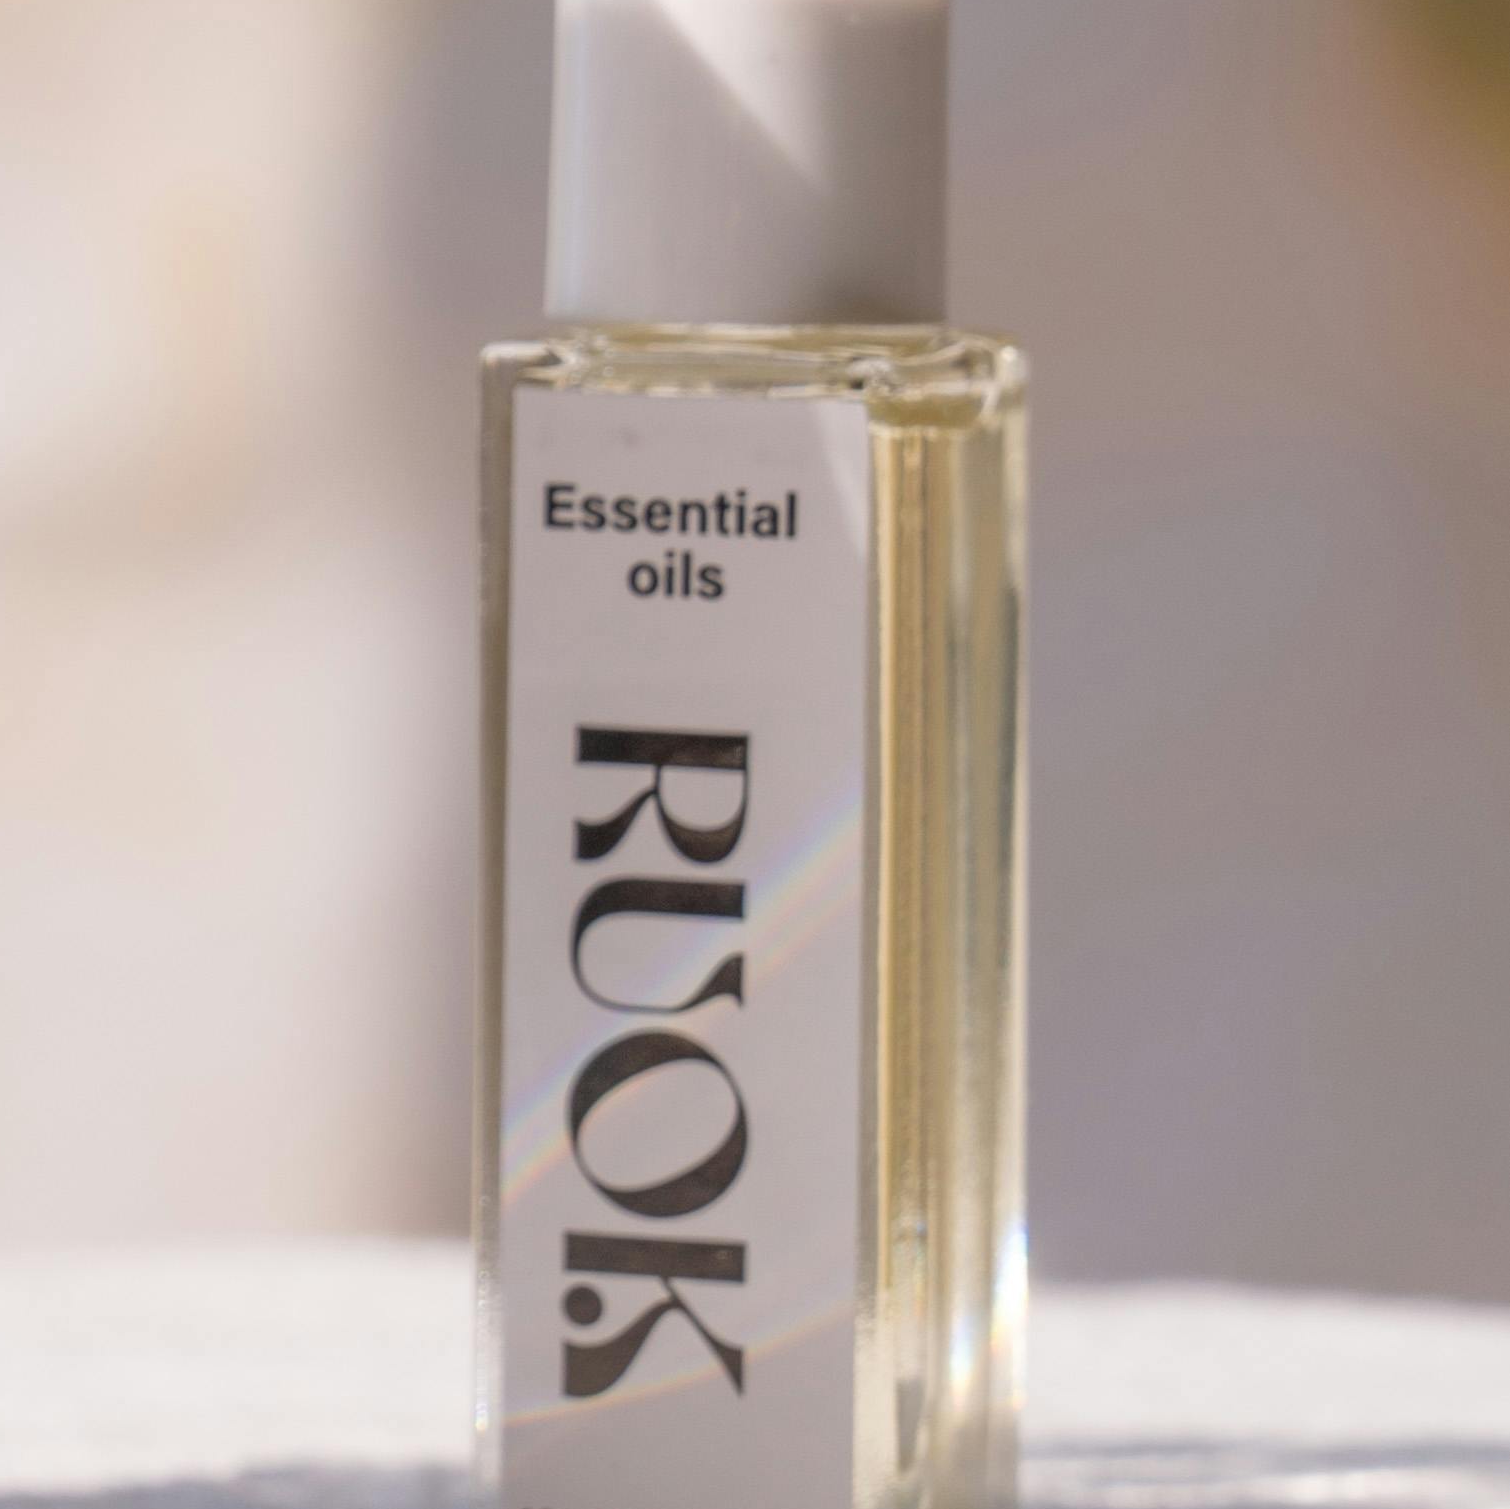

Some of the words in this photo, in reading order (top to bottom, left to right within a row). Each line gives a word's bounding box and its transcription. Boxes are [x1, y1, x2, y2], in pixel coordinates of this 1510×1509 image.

[544, 482, 798, 539] Essential
[626, 548, 726, 600] oils
[559, 724, 753, 1399] RUOK
